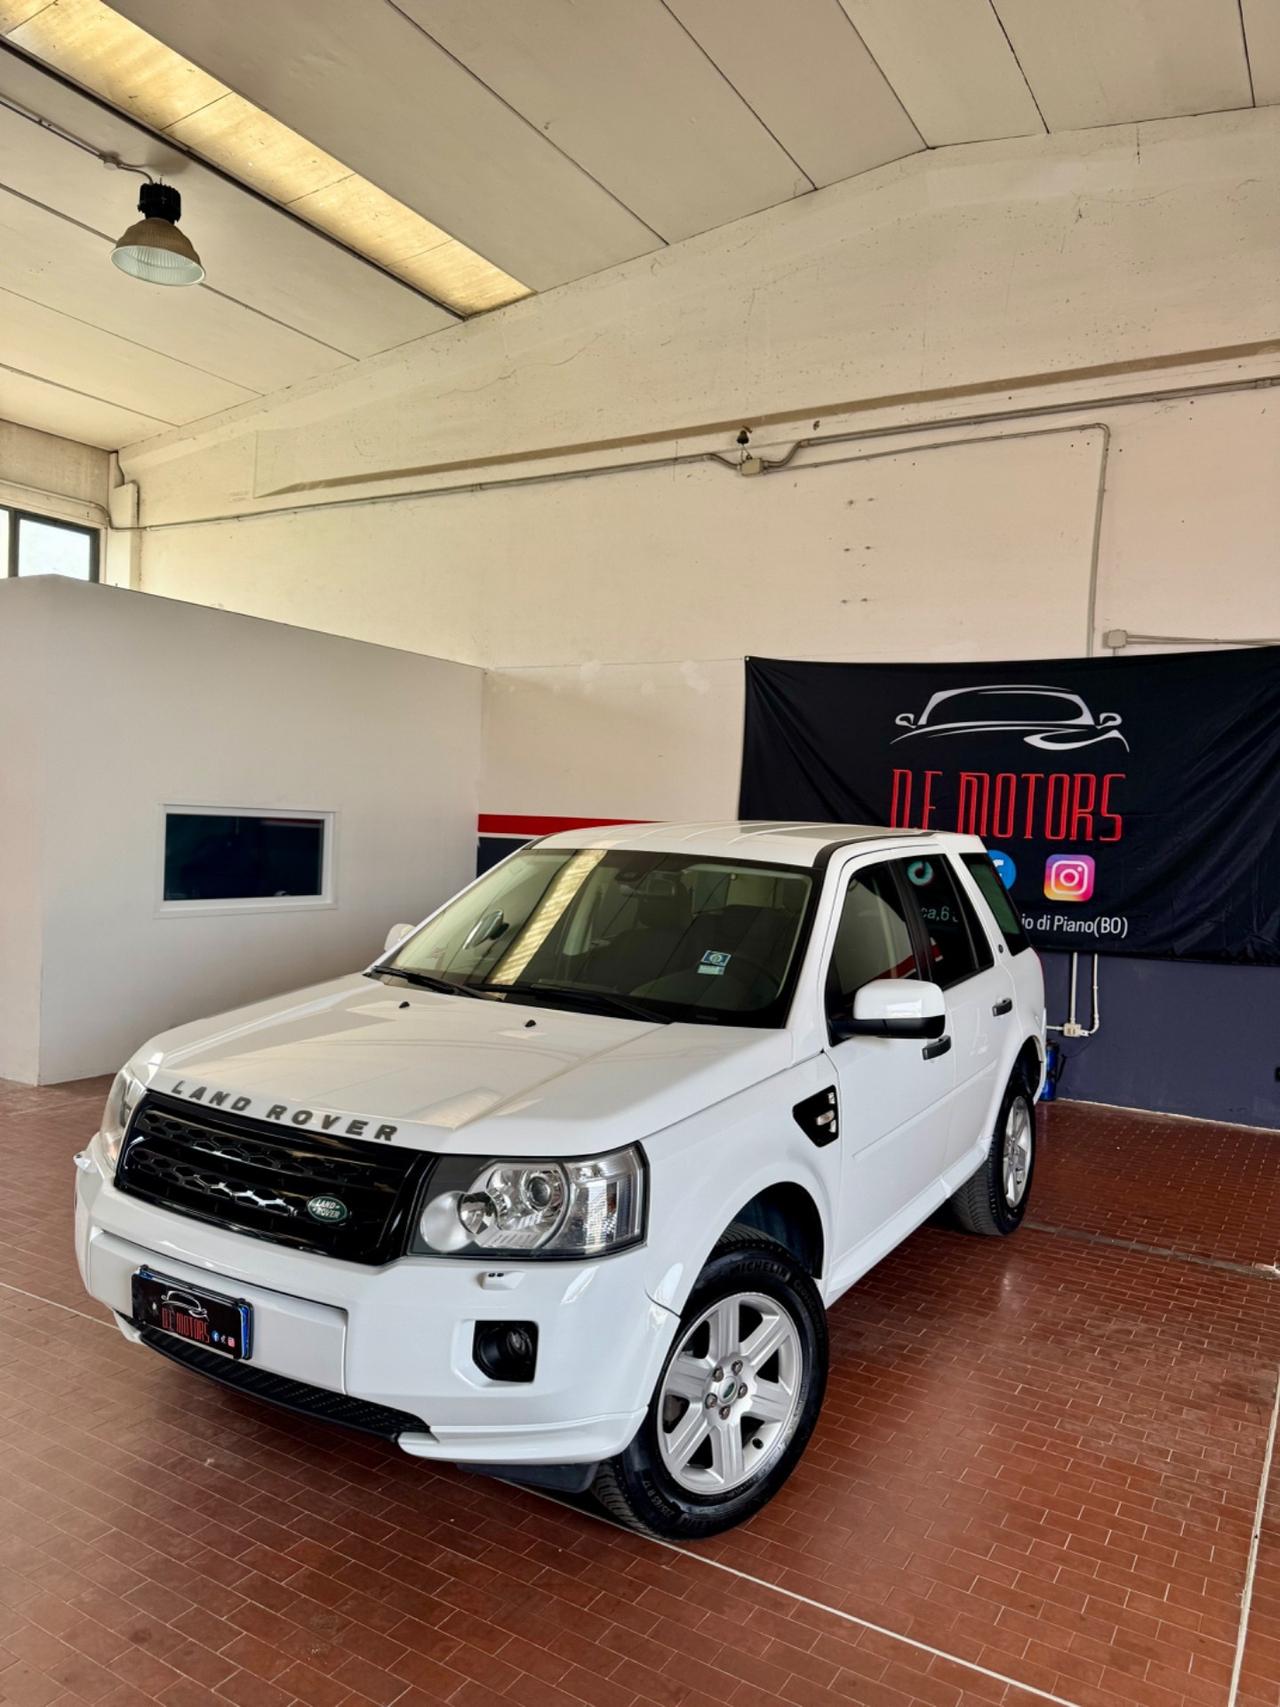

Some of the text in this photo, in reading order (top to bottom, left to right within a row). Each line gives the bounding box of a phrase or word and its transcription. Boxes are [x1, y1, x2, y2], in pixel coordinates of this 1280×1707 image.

[956, 771, 1126, 841] MOTORS
[1036, 914, 1051, 931] di
[1053, 915, 1129, 938] Piano(BO)
[170, 1080, 399, 1142] LAND ROVER
